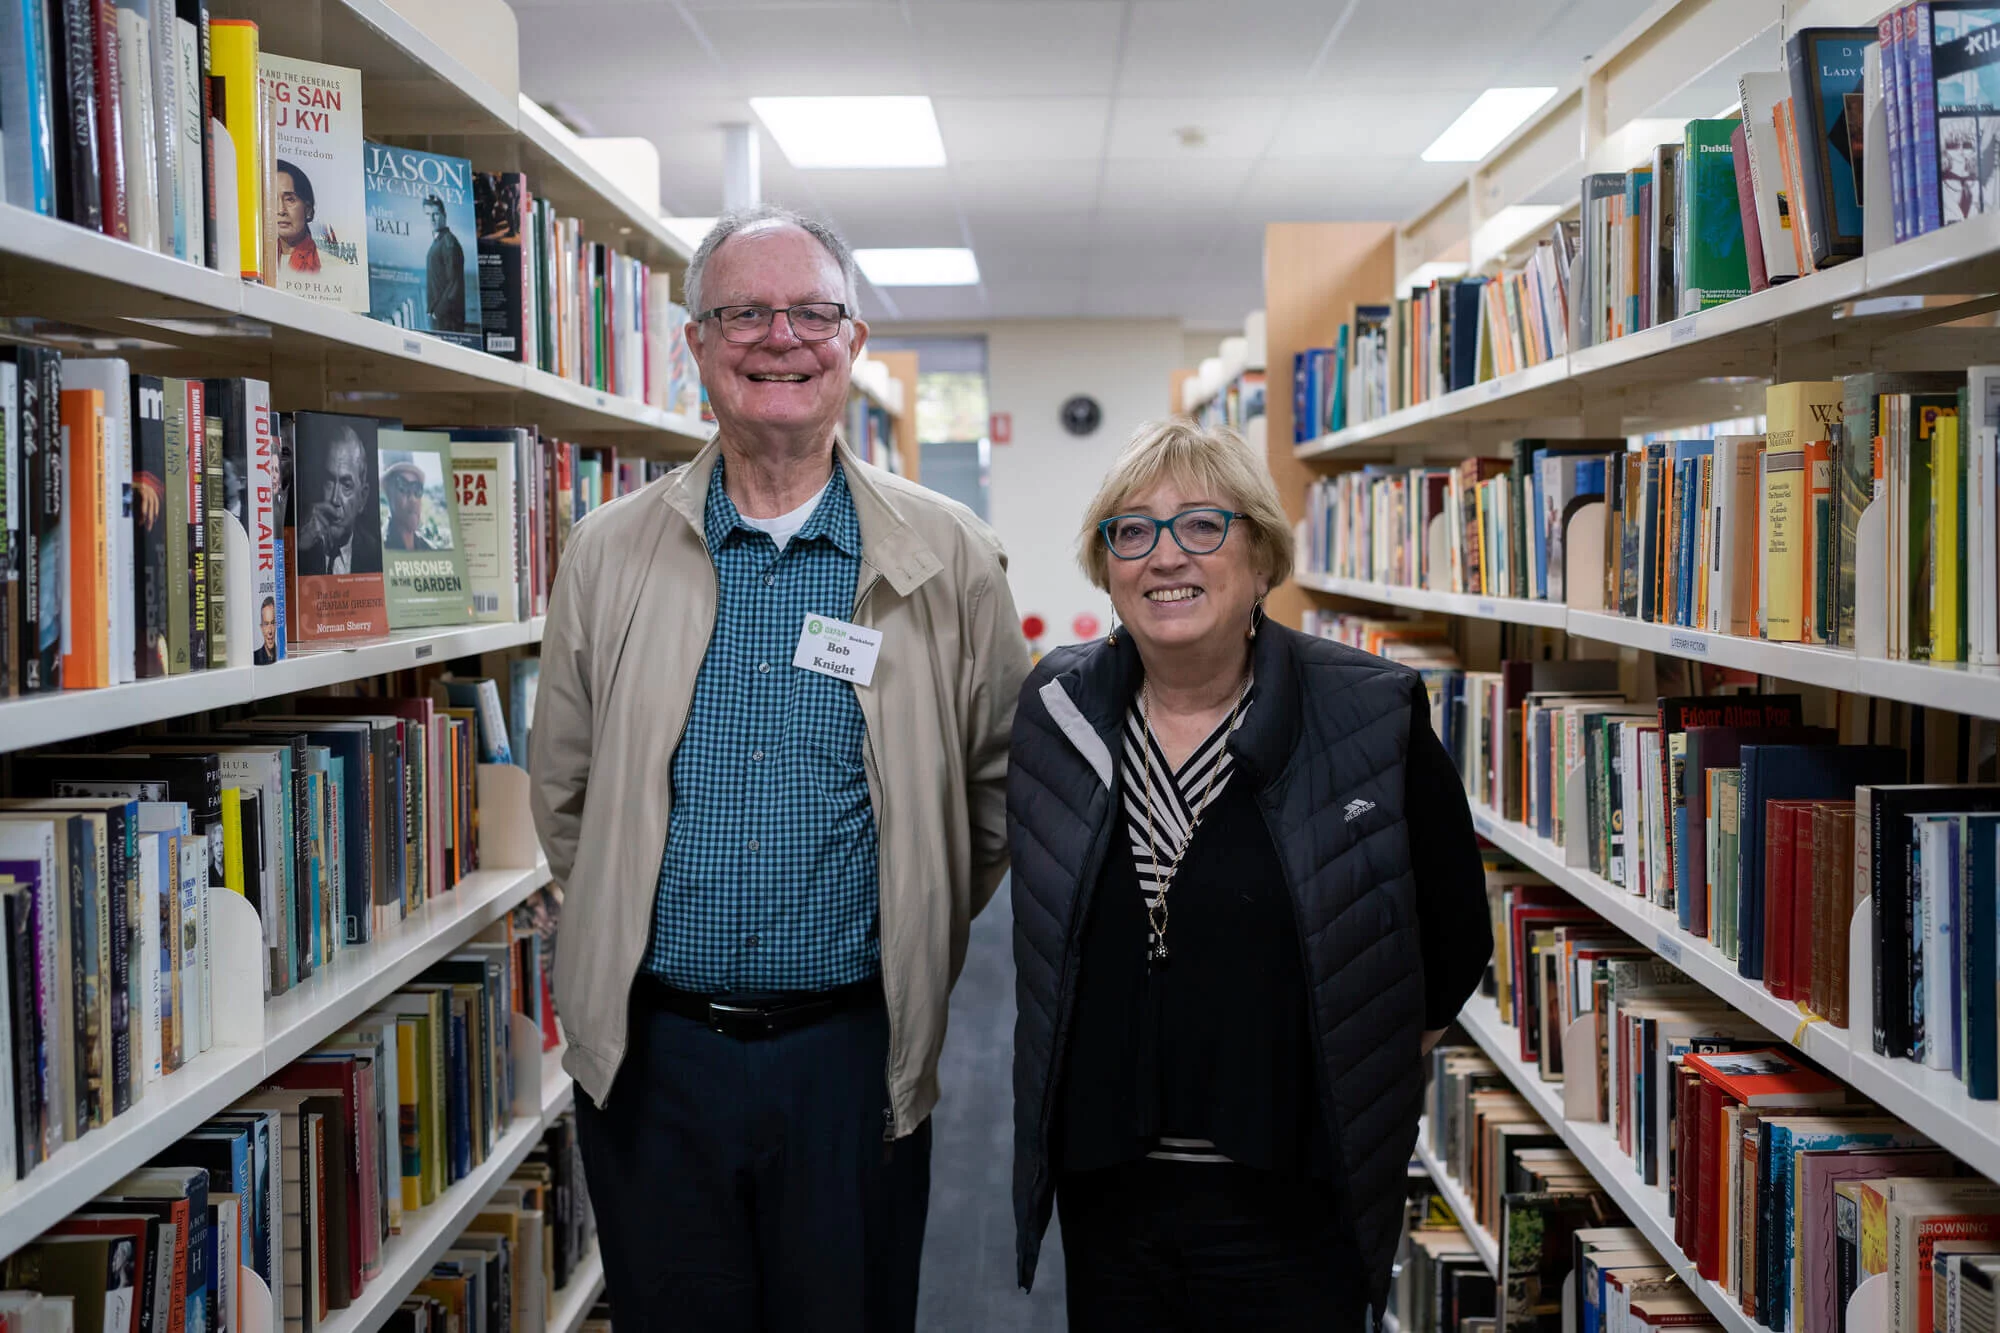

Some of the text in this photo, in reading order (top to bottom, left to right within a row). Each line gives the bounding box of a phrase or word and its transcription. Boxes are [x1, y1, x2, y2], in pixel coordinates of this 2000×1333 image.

[1965, 28, 2000, 56] KIL
[266, 69, 341, 90] AND THE GENERALS
[297, 85, 342, 111] SAN
[295, 109, 329, 133] KYI
[277, 144, 334, 160] for freedom
[366, 147, 465, 190] JASON
[375, 218, 410, 236] BALI
[286, 281, 343, 294] POPHAM
[192, 388, 202, 432] SMOKING
[194, 433, 202, 473] MONKEYS
[254, 401, 274, 571] TONY BLAIR
[195, 484, 203, 523] DRILLING
[195, 552, 204, 583] PAUL
[394, 560, 454, 577] PRISONER
[399, 577, 411, 587] THE
[413, 576, 462, 593] GARDEN
[144, 565, 158, 649] robb
[195, 584, 205, 632] CARTER
[316, 621, 372, 634] Norman Sherry
[826, 641, 851, 656] Bob
[812, 656, 856, 676] Knight
[1680, 706, 1721, 729] Edgar
[297, 749, 308, 802] JEFFREY
[301, 806, 309, 862] ARCHER
[1856, 825, 1868, 895] QUO
[176, 1209, 186, 1246] Emma:
[1919, 1222, 1989, 1234] BROWNING
[175, 1246, 185, 1269] The
[192, 1248, 202, 1274] H
[174, 1271, 184, 1291] Life
